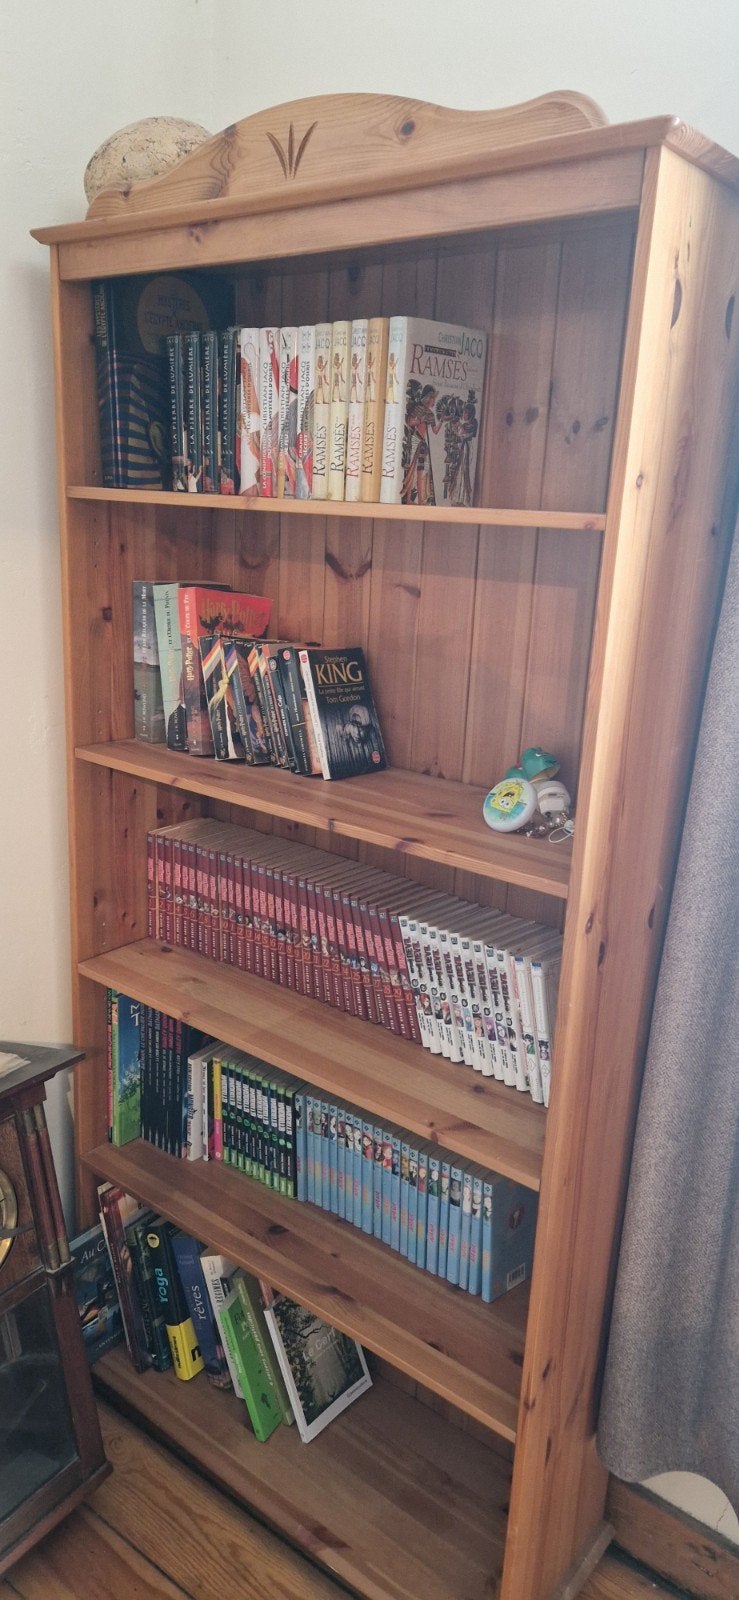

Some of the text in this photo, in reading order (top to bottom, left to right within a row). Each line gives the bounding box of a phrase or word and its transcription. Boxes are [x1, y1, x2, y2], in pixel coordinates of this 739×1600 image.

[460, 332, 484, 358] JACQ
[315, 661, 363, 685] KING
[326, 694, 361, 704] Tom Gordon
[80, 1248, 94, 1264] Au
[192, 1285, 207, 1320] rêves
